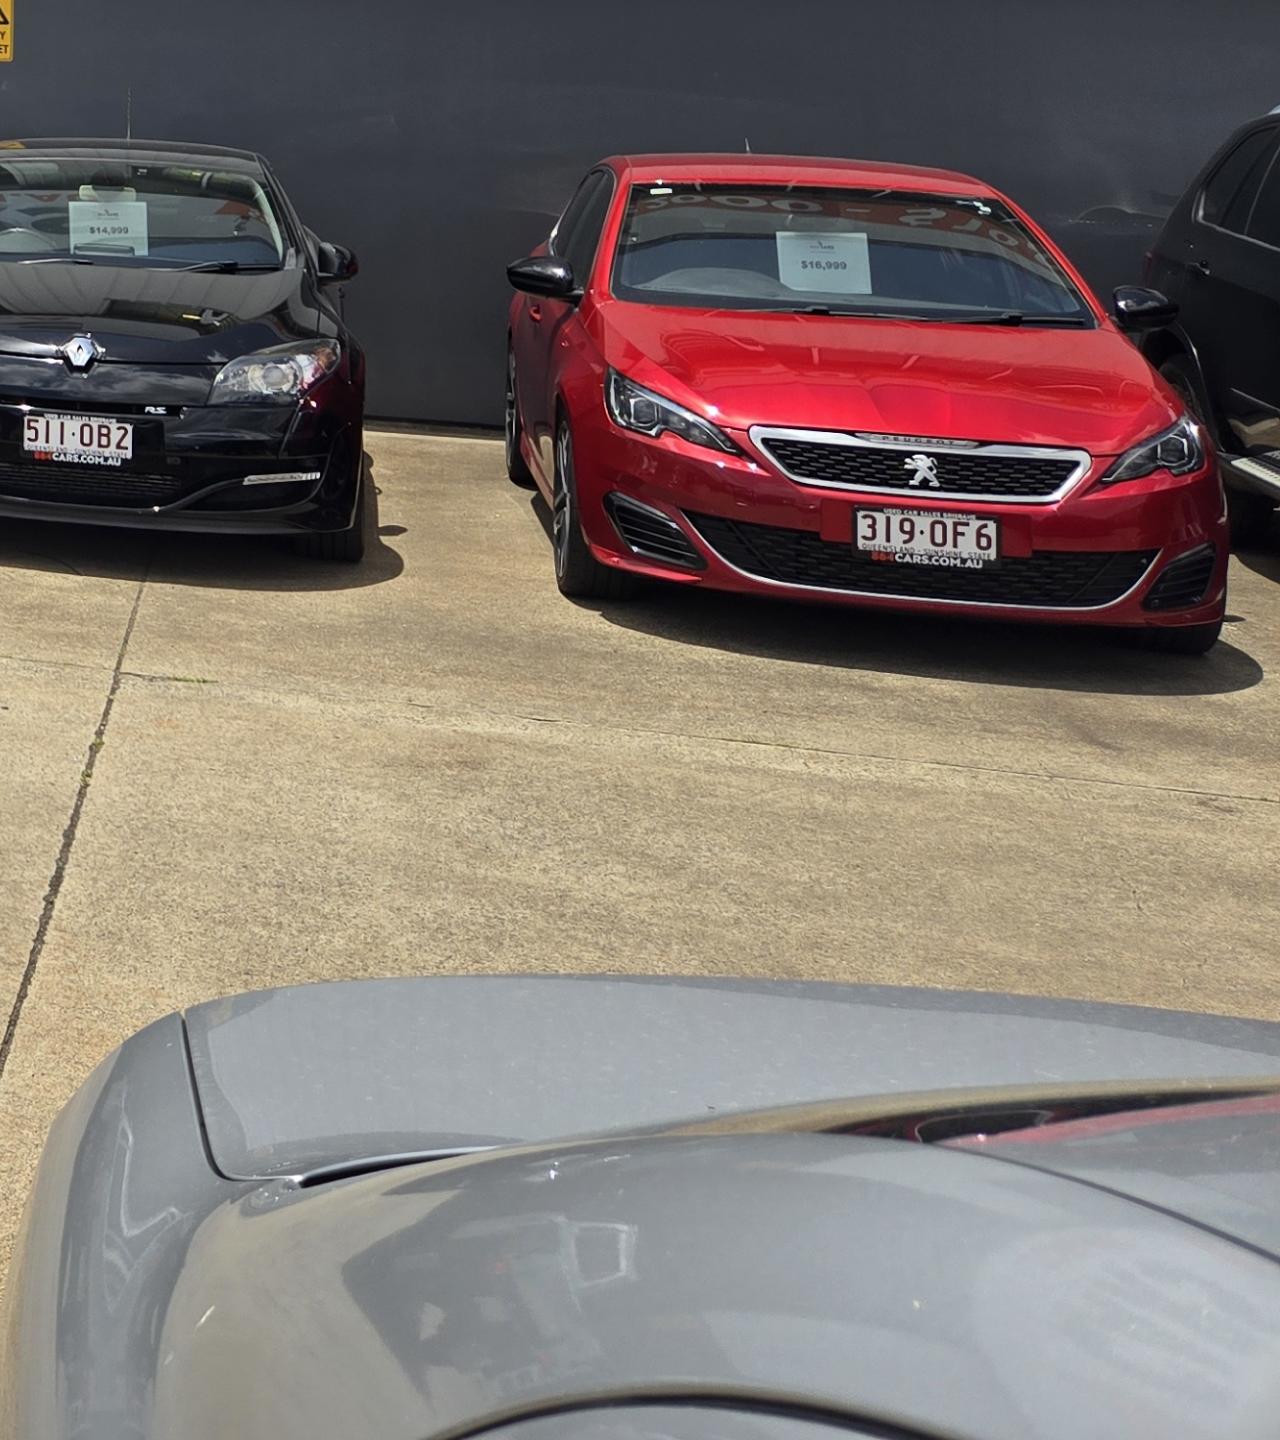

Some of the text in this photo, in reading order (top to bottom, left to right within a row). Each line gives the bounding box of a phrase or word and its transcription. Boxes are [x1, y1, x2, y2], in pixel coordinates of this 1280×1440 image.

[800, 260, 848, 271] $16,999
[881, 435, 956, 446] PEUGEOT
[861, 543, 915, 554] QUEENSLAND
[923, 548, 963, 559] SUNSHINE
[967, 551, 992, 561] STATE
